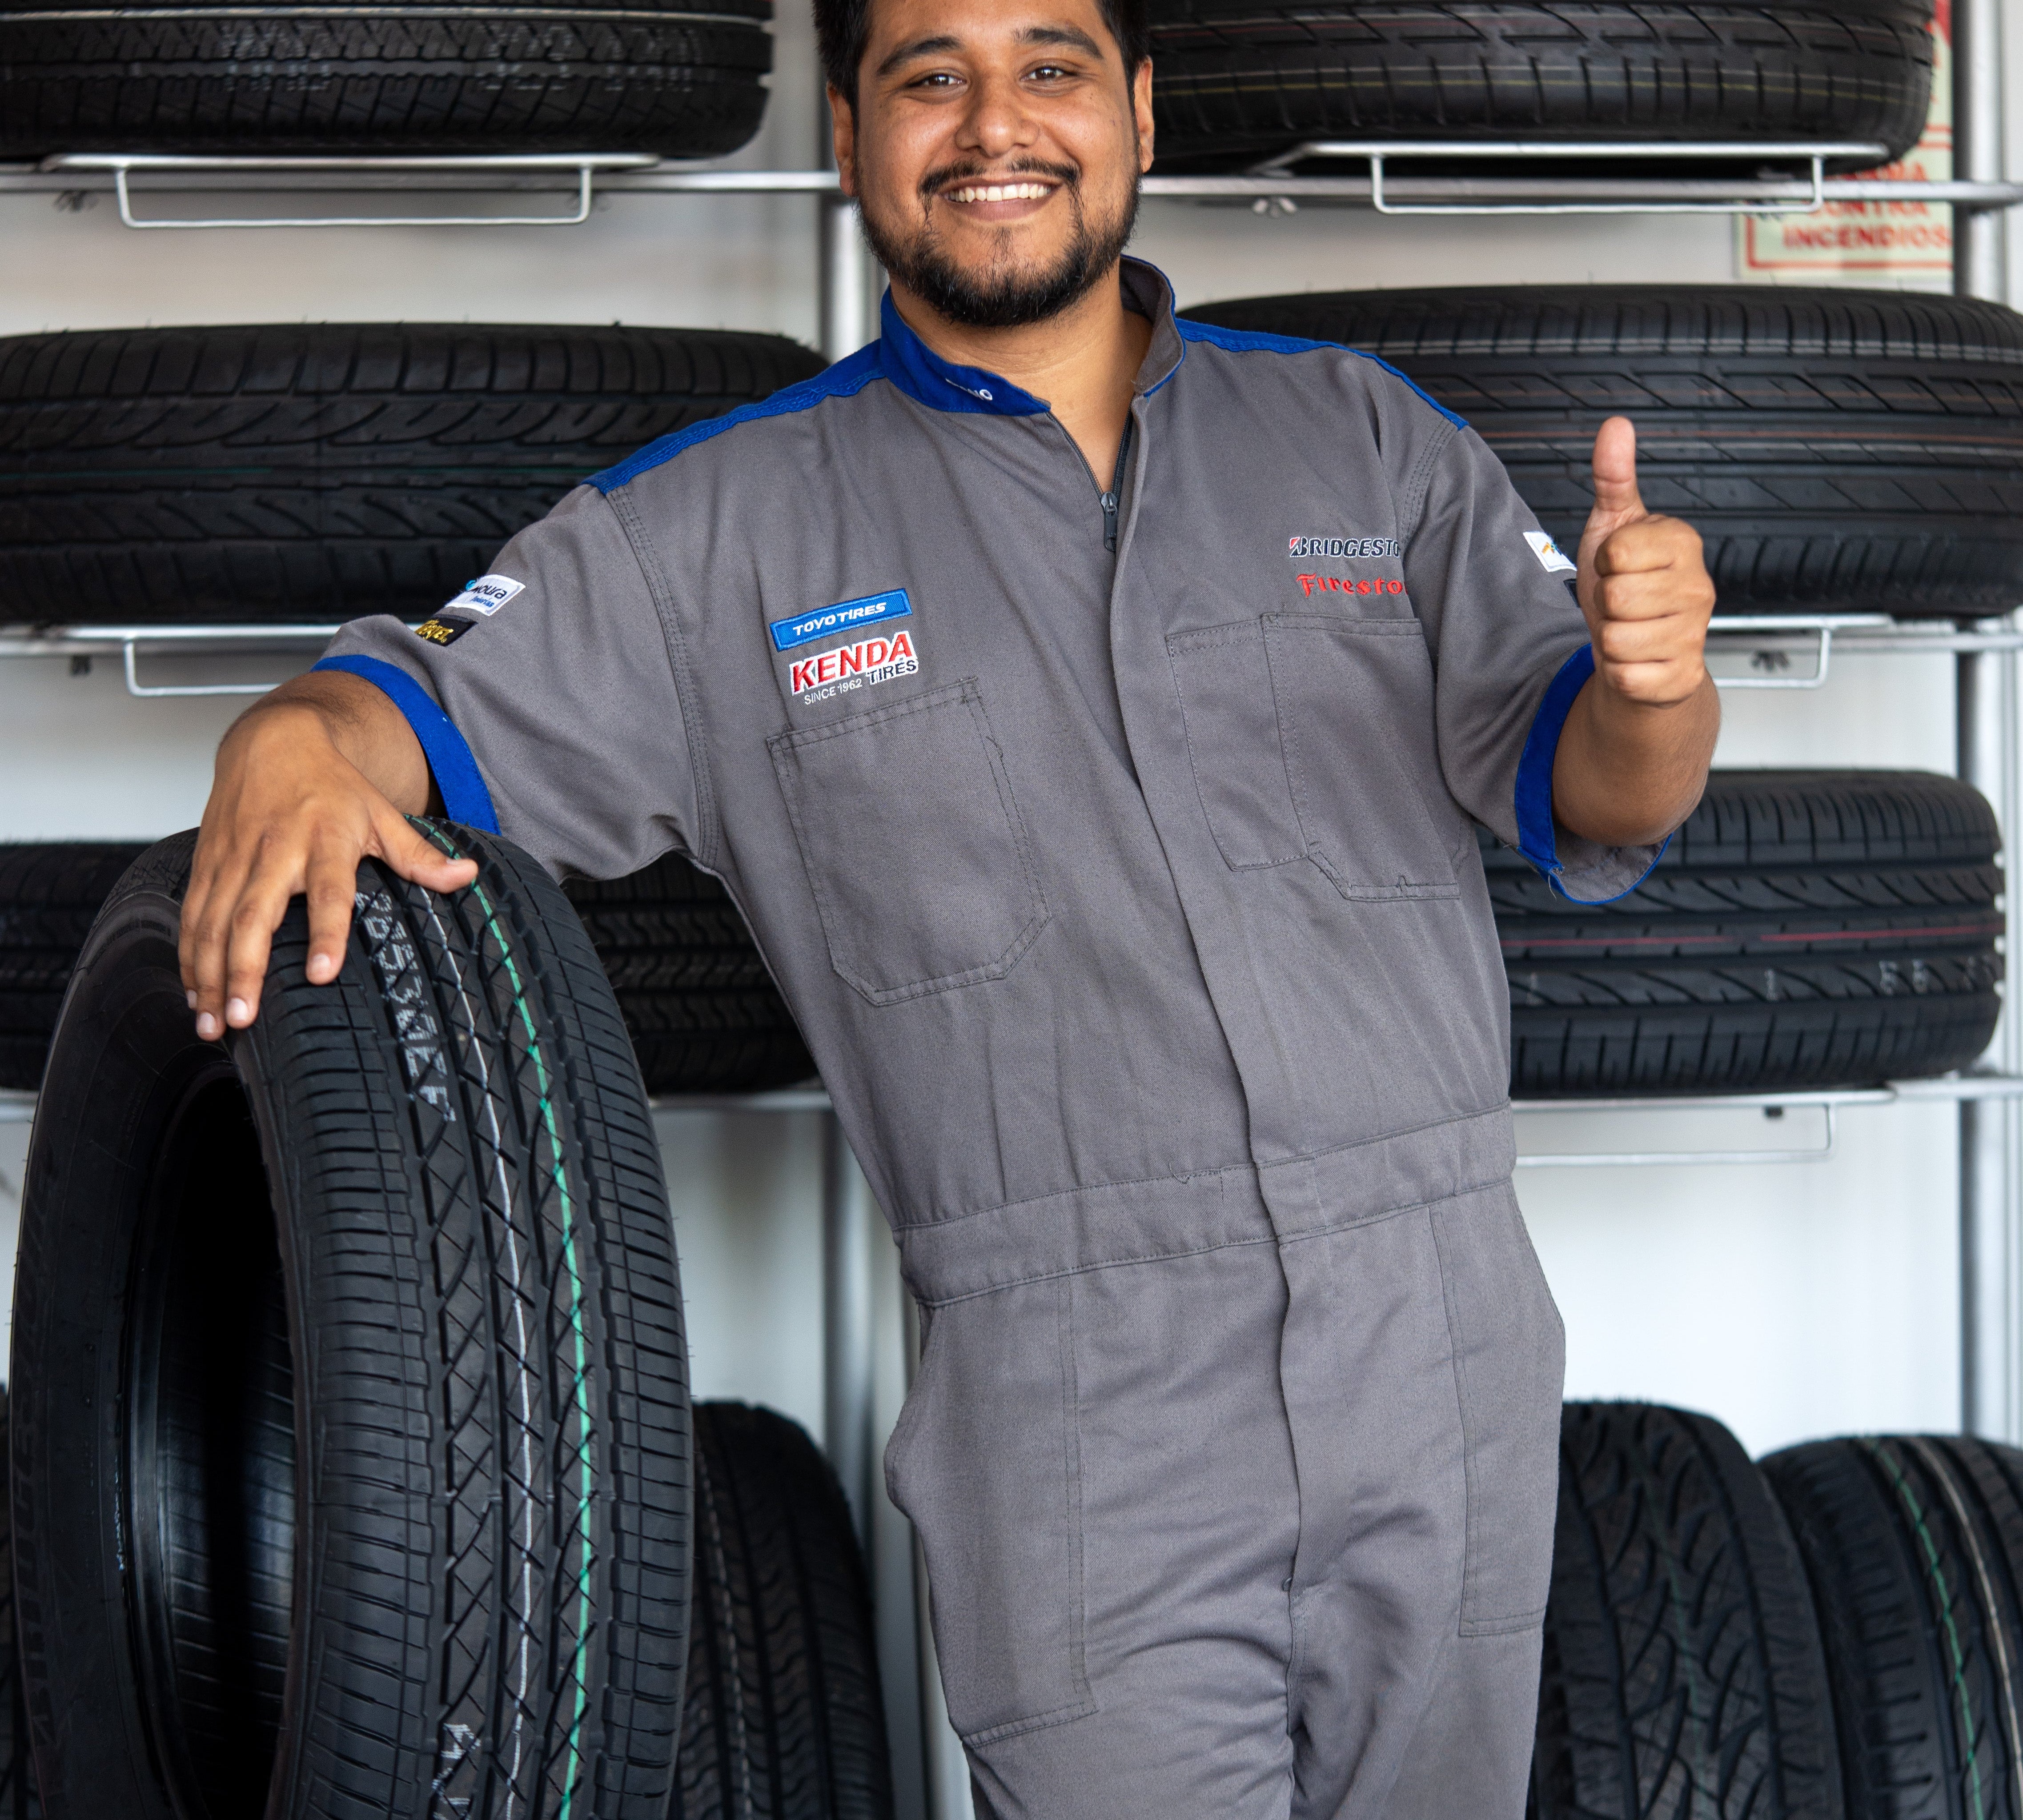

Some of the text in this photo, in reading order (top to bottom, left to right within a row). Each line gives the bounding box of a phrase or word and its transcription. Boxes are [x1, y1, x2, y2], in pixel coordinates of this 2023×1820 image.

[1804, 201, 1930, 217] ONTRA
[1783, 224, 1951, 249] INCENDIOS
[1296, 573, 1409, 597] Firesto
[792, 602, 887, 636] TOYO TIRES
[790, 631, 917, 696] KENDA
[867, 660, 918, 685] TIRES
[804, 678, 863, 705] SINCE 1962
